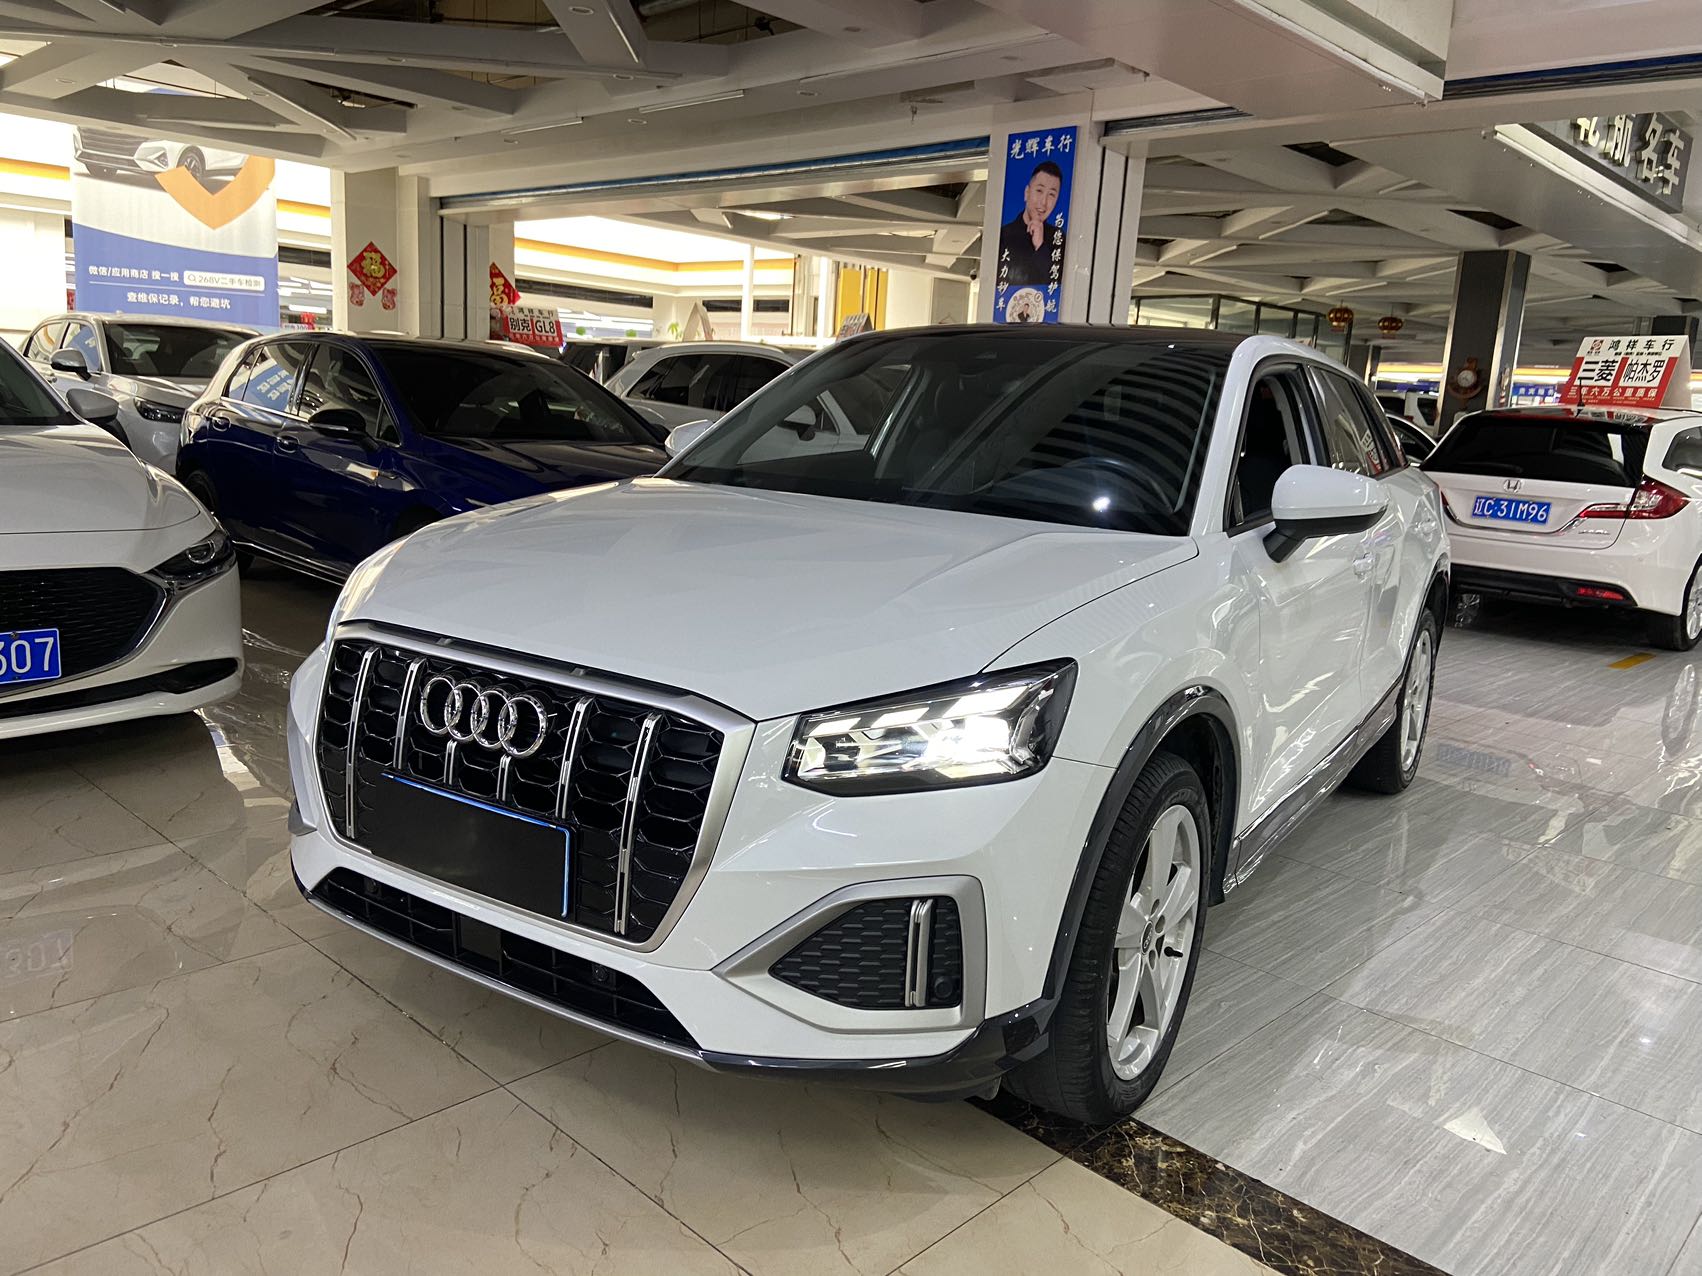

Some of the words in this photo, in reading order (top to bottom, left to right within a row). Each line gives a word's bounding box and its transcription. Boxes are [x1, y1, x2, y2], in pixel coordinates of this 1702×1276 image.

[1010, 134, 1073, 159] 光辉车行
[88, 265, 149, 280] 微信/应用商店
[151, 270, 180, 282] 搜一搜
[509, 317, 531, 332] 别克
[534, 320, 556, 335] GL8
[1608, 339, 1675, 351] 鸿祥车行
[1577, 359, 1618, 382] 三菱
[1623, 359, 1665, 383] 帕杰罗
[1569, 386, 1658, 397] 三年六万公里质保
